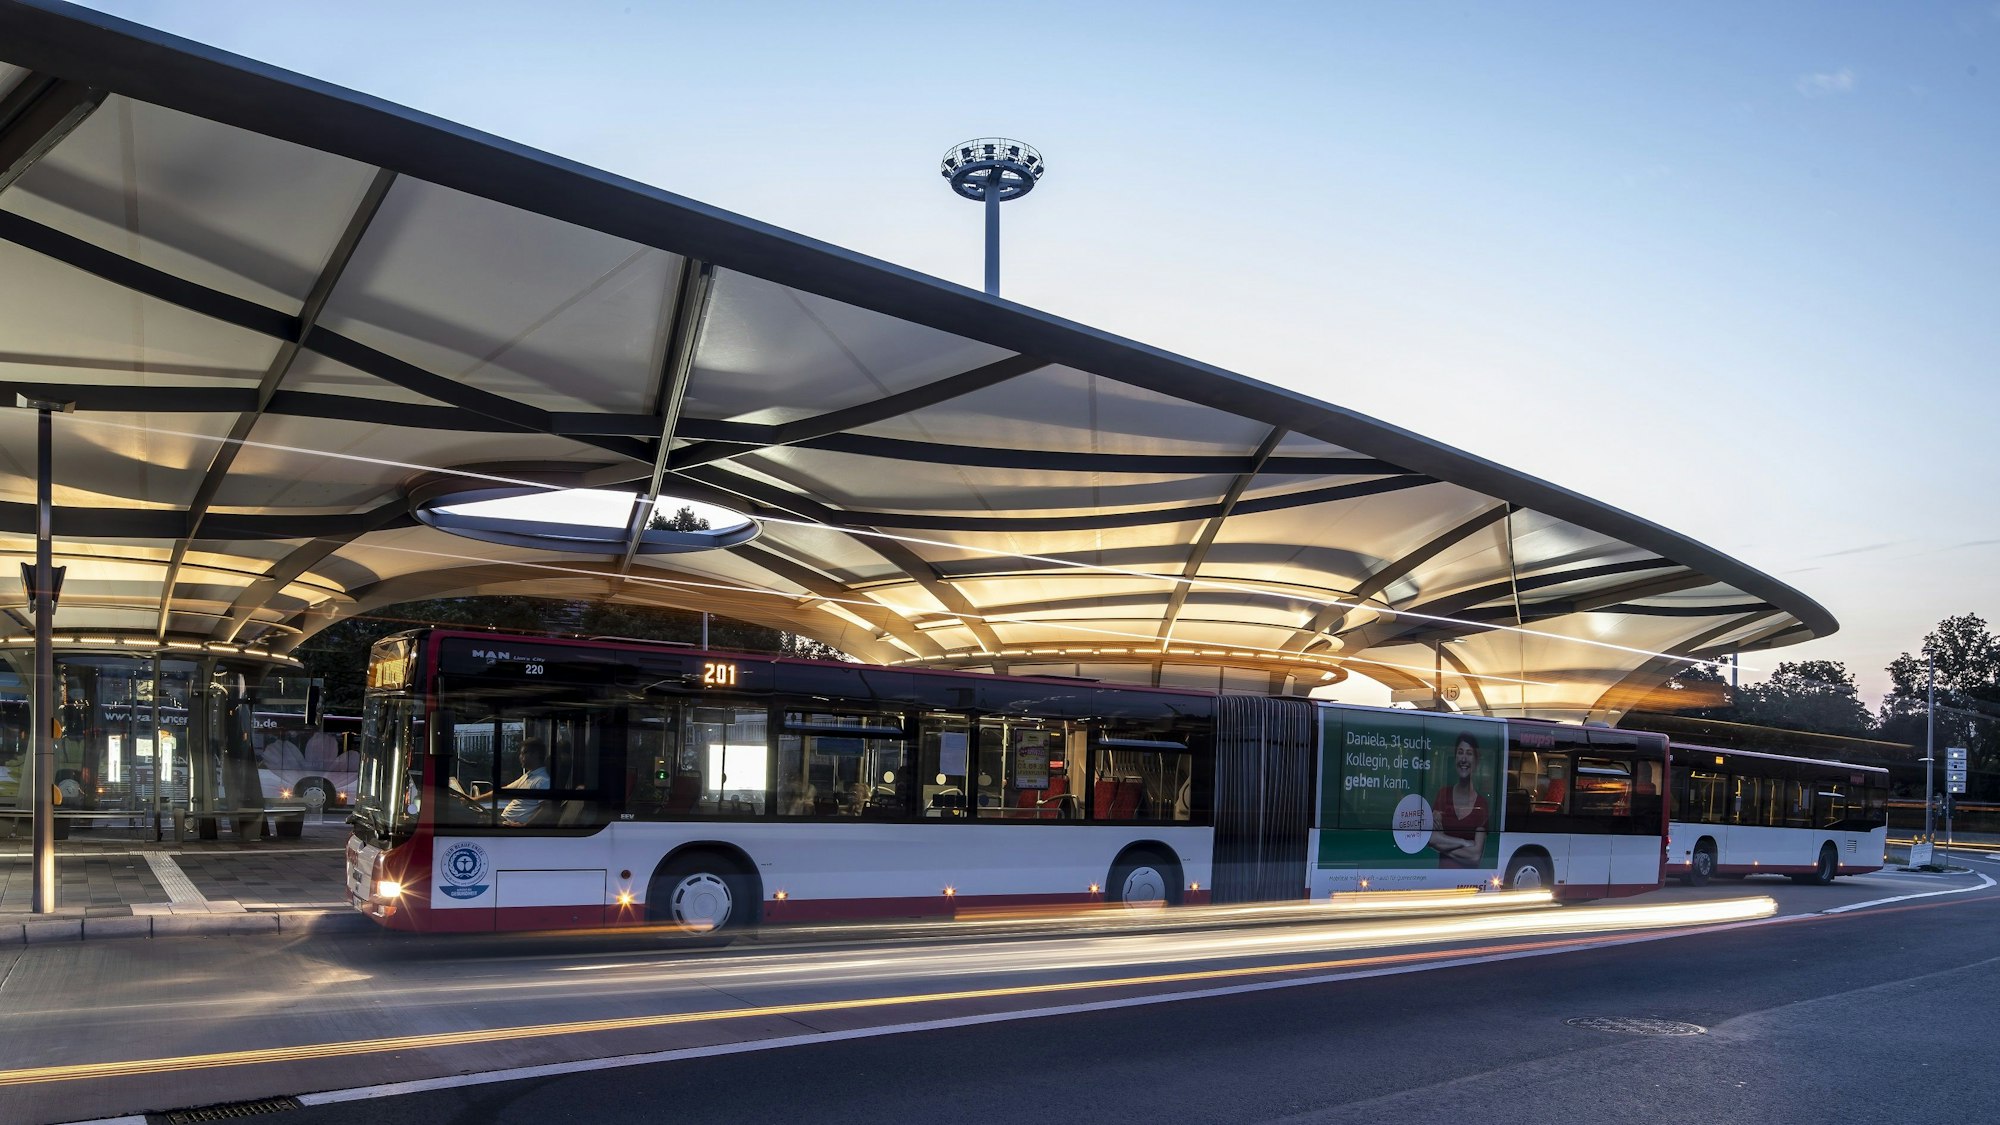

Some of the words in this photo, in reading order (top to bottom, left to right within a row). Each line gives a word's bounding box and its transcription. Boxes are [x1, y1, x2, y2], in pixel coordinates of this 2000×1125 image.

[472, 649, 510, 660] MAN
[525, 664, 544, 675] 220
[704, 663, 736, 685] 201
[1444, 686, 1457, 699] 15
[1346, 731, 1388, 749] Daniela,
[1390, 734, 1401, 748] 31
[1403, 735, 1432, 750] sucht
[1520, 731, 1556, 747] wupsi
[1346, 752, 1390, 770] Kollegin,
[1393, 754, 1409, 769] die
[1411, 756, 1431, 770] Gas
[1344, 772, 1380, 791] geben
[1383, 774, 1411, 789] kann.
[1401, 810, 1425, 818] FAHRER
[1399, 819, 1425, 829] GESUCHT
